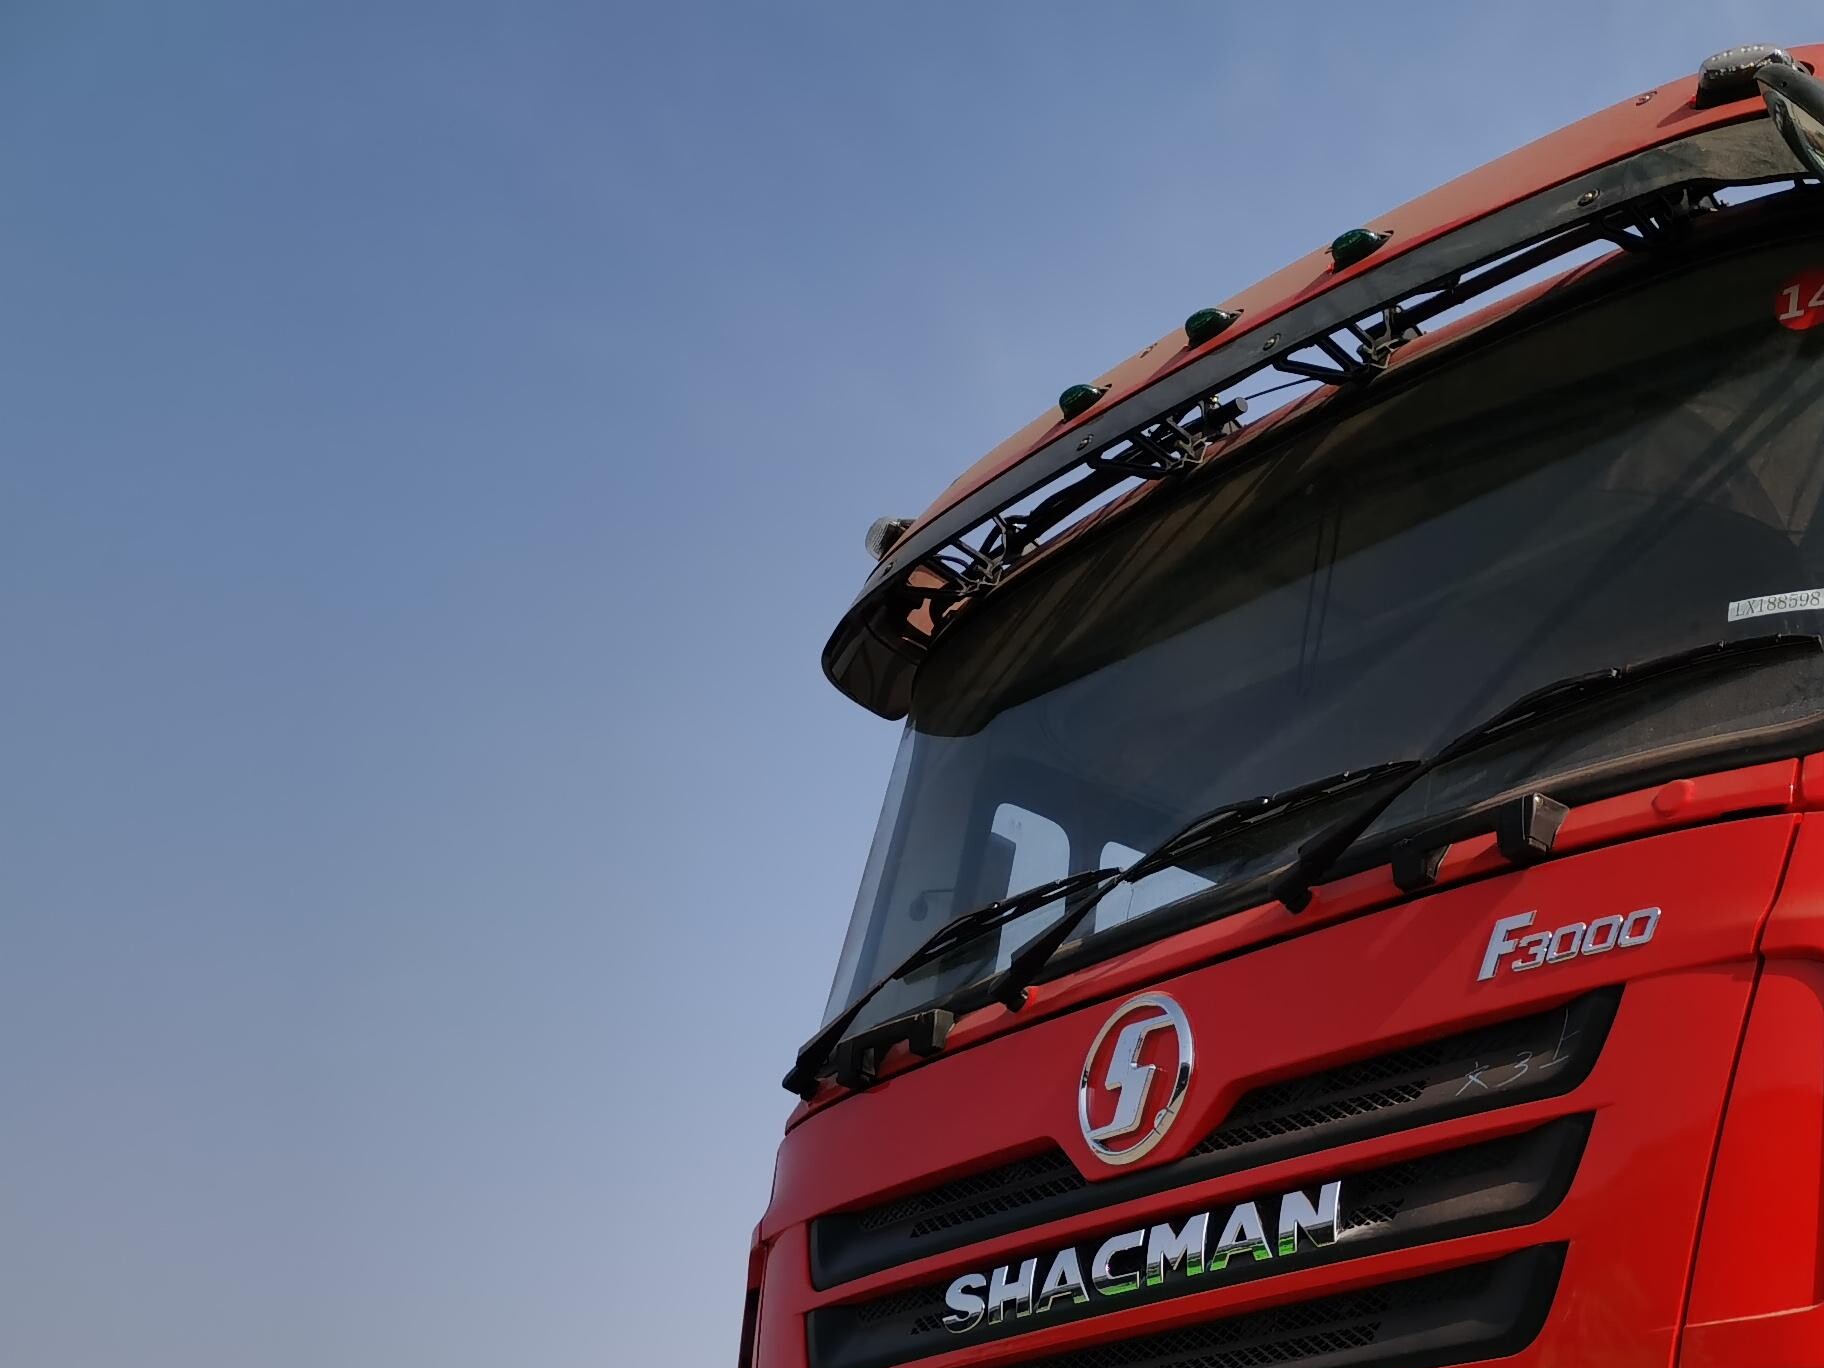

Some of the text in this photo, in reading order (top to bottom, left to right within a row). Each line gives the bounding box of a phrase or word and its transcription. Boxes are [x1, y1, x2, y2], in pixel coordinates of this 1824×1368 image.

[1735, 590, 1822, 617] LX188598
[1477, 906, 1662, 982] F3000
[942, 1180, 1342, 1334] SHACMAN
